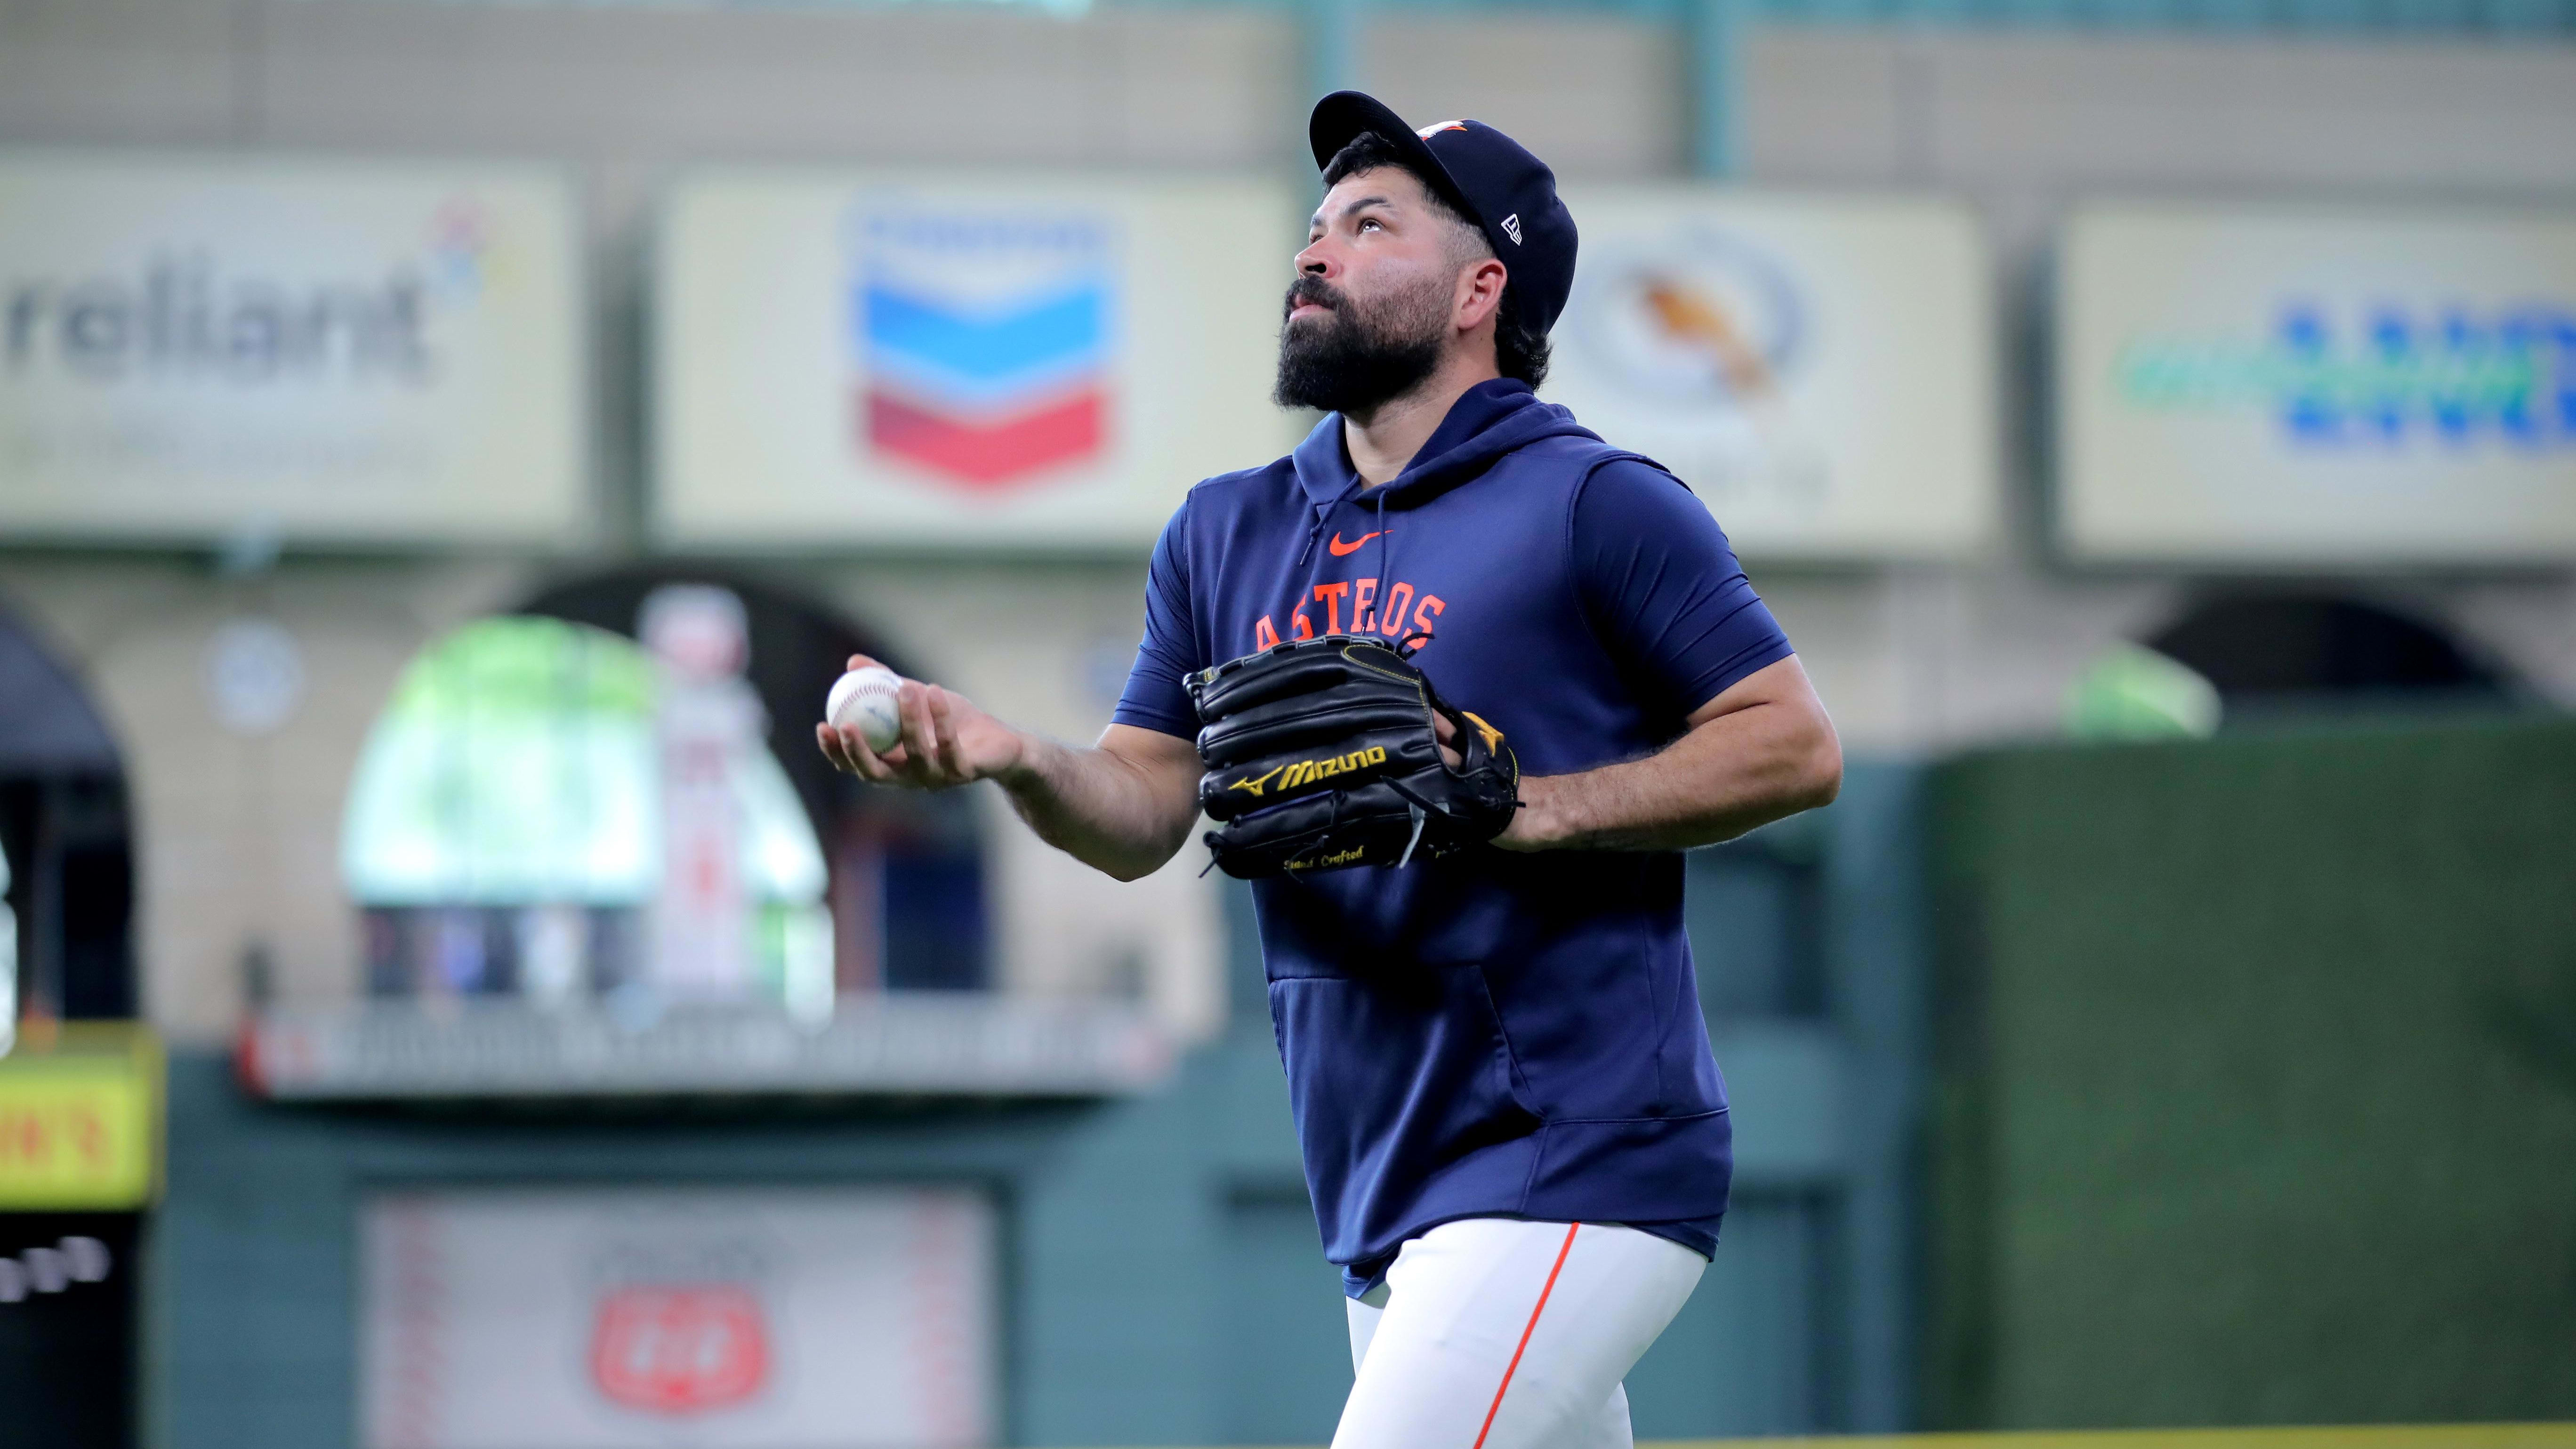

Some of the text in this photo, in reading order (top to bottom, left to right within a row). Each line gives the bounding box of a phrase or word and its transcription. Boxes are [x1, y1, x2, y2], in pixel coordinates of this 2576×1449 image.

[5, 252, 435, 384] reliant
[1256, 579, 1446, 650] ASTROS
[1321, 845, 1364, 867] Crafted
